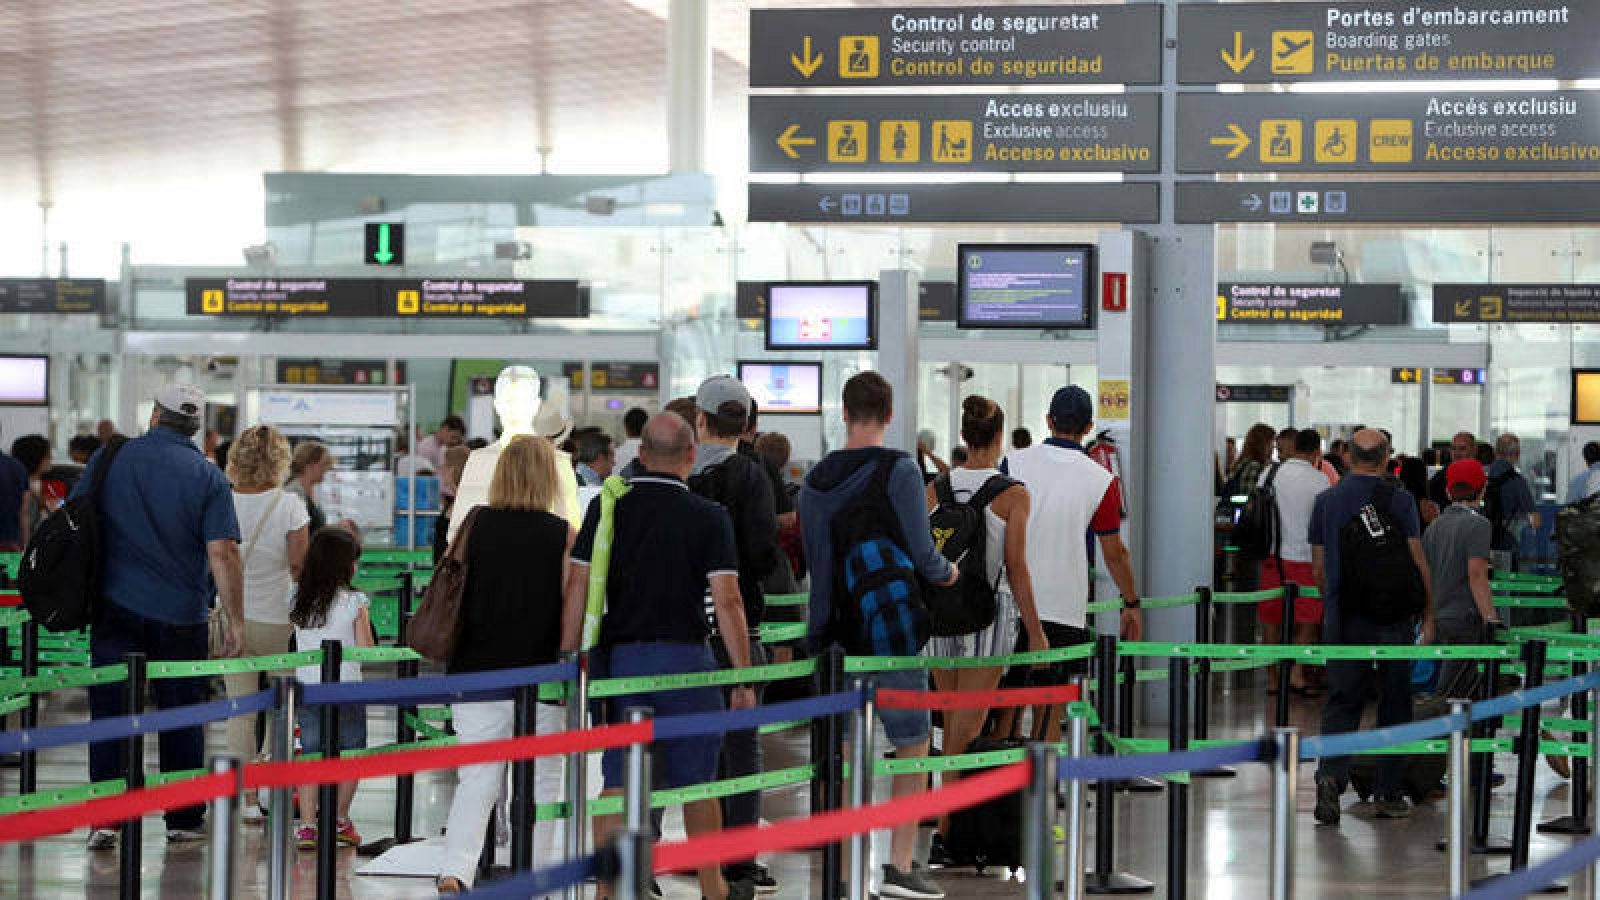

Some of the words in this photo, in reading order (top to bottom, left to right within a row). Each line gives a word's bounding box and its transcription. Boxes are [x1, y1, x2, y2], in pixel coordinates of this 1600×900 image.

[891, 13, 964, 32] Control
[971, 13, 995, 31] de
[1002, 13, 1099, 34] seguretat
[1327, 8, 1394, 27] Portes
[1403, 6, 1569, 26] d'embarcament
[891, 36, 953, 55] Security
[961, 36, 1015, 53] control
[1326, 31, 1398, 50] Boarding
[1405, 31, 1451, 50] gates
[891, 57, 963, 76] Control
[970, 56, 994, 75] de
[1002, 55, 1102, 78] seguridad
[1326, 53, 1406, 72] Puertas
[1414, 51, 1439, 71] de
[1449, 51, 1556, 72] embarque
[1050, 99, 1128, 117] exclusiu
[1493, 96, 1577, 115] exclusiu
[983, 121, 1052, 138] Exclusive
[1055, 124, 1107, 138] access
[1424, 120, 1497, 137] Exclusive
[1501, 122, 1557, 137] access
[984, 143, 1055, 161] Acceso
[1060, 143, 1150, 161] exclusivo
[1425, 142, 1499, 161] Acceso
[1504, 141, 1600, 161] exclusivo
[1232, 286, 1270, 297] Control
[1232, 307, 1270, 319] Control
